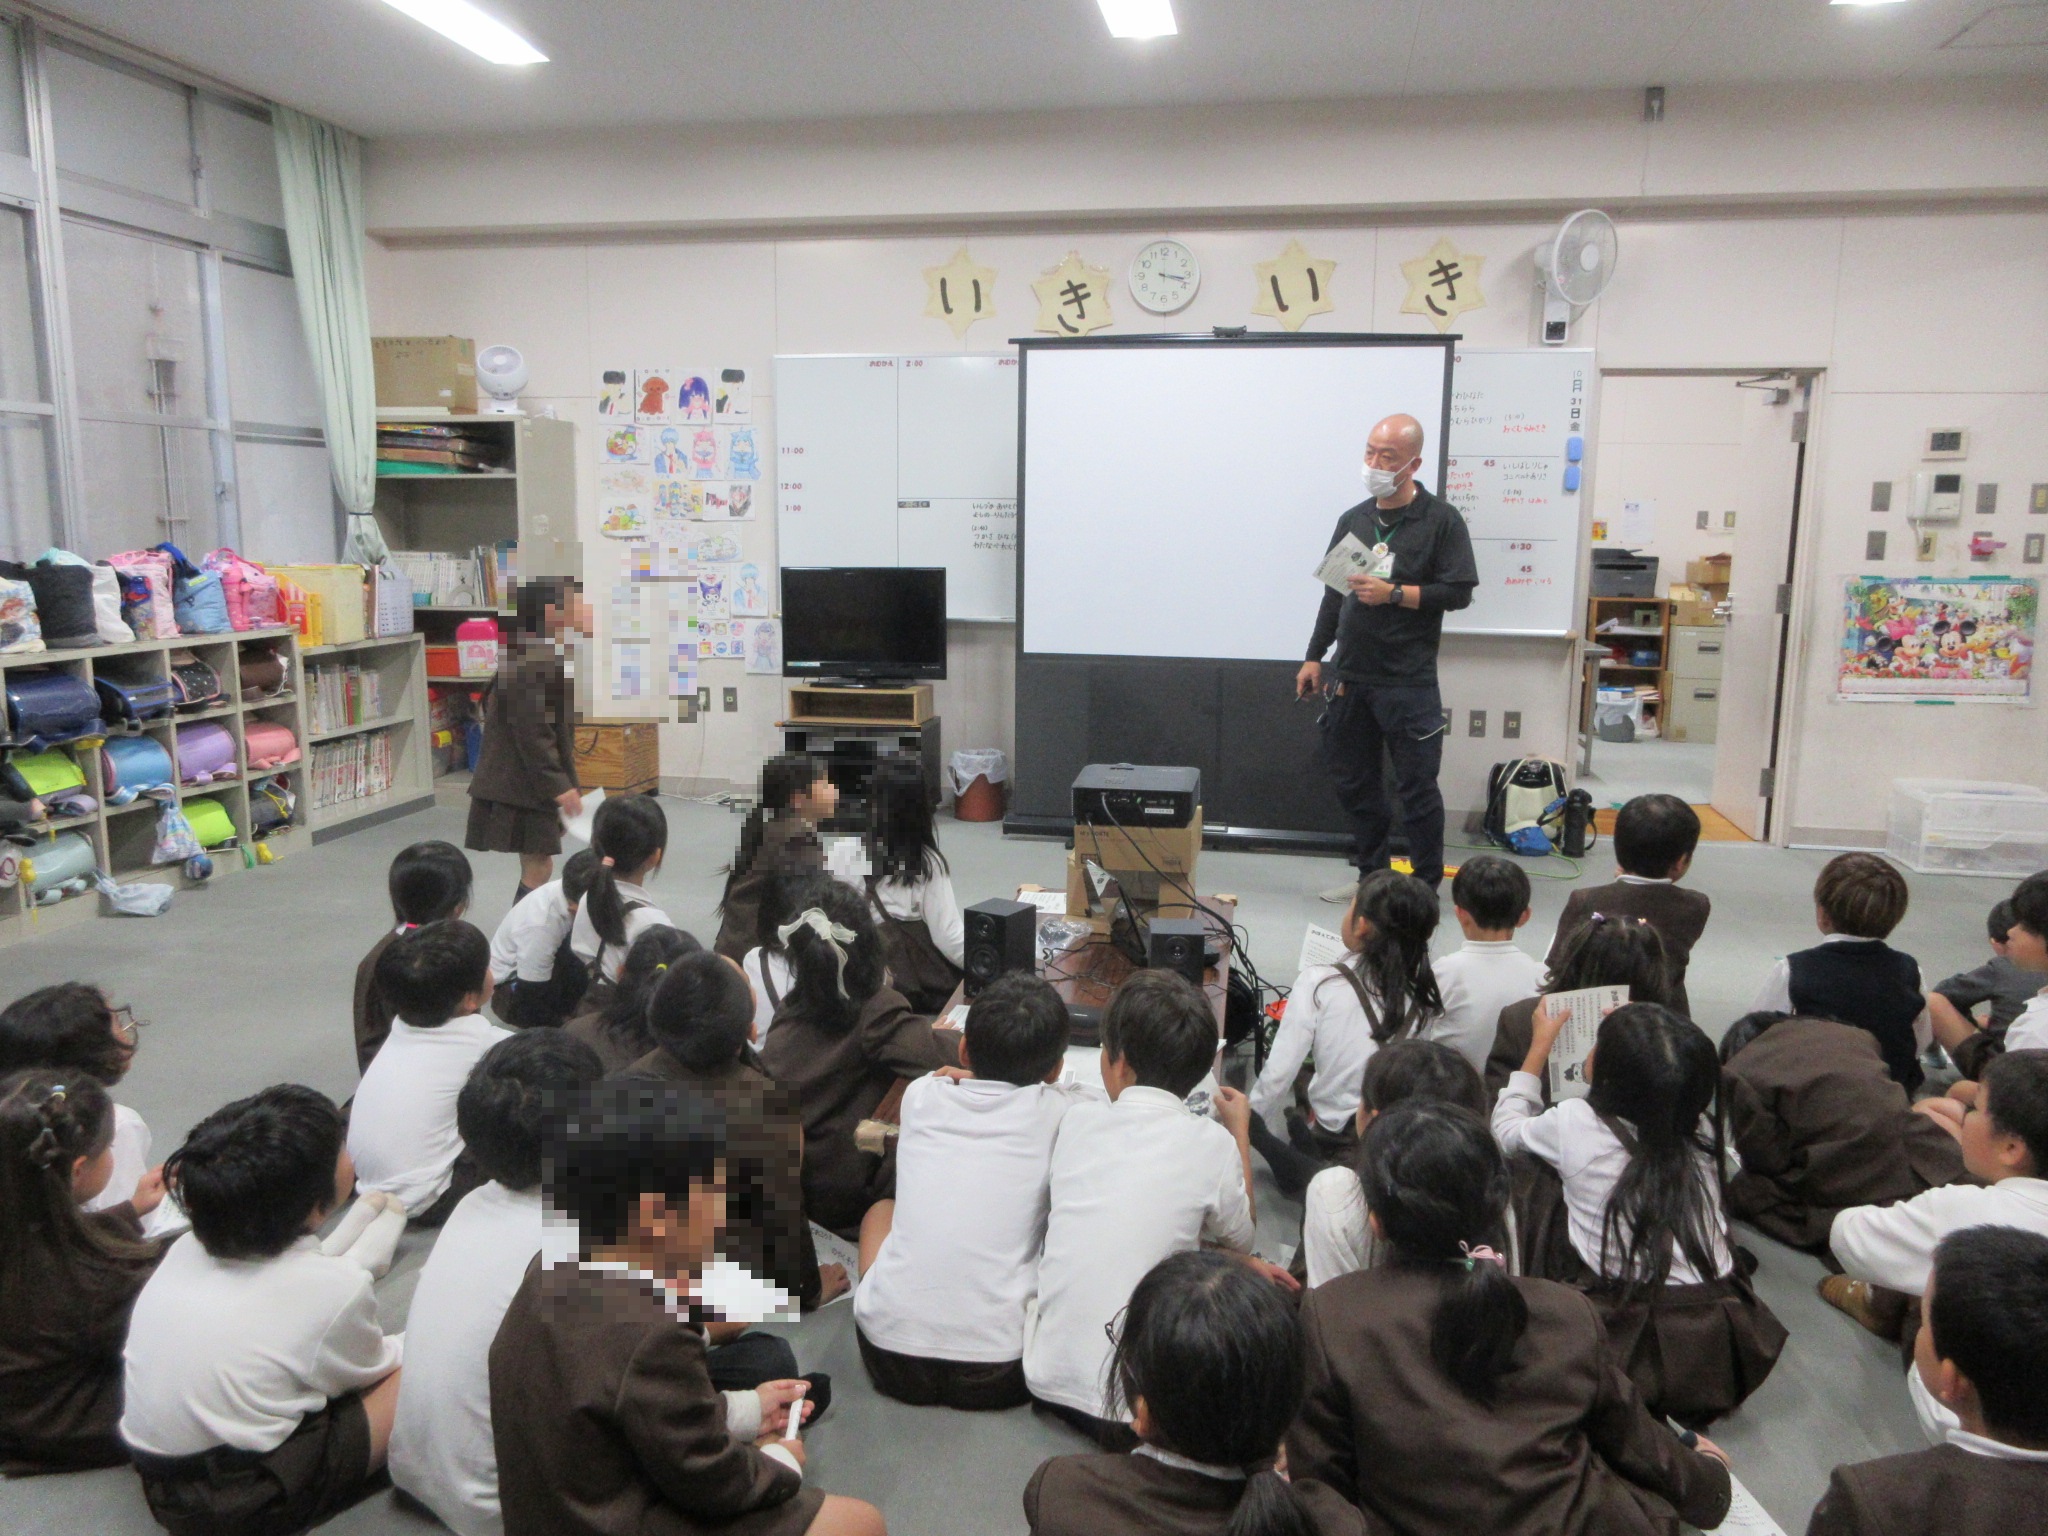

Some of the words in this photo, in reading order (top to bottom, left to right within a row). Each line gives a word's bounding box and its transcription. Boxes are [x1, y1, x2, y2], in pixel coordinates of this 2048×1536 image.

[1160, 247, 1169, 256] 12
[1142, 260, 1151, 269] 10
[1180, 259, 1187, 267] 2
[1137, 272, 1145, 280] 9
[1184, 271, 1191, 279] 3
[1141, 283, 1148, 291] 8
[1180, 282, 1187, 290] 4
[941, 277, 980, 313] い
[1058, 280, 1091, 333] き
[1271, 267, 1318, 312] い
[1425, 259, 1462, 315] き
[1150, 292, 1156, 300] 7
[1160, 295, 1167, 303] 6
[1172, 291, 1179, 300] 5
[1483, 459, 1495, 467] 45
[1520, 565, 1532, 573] 45
